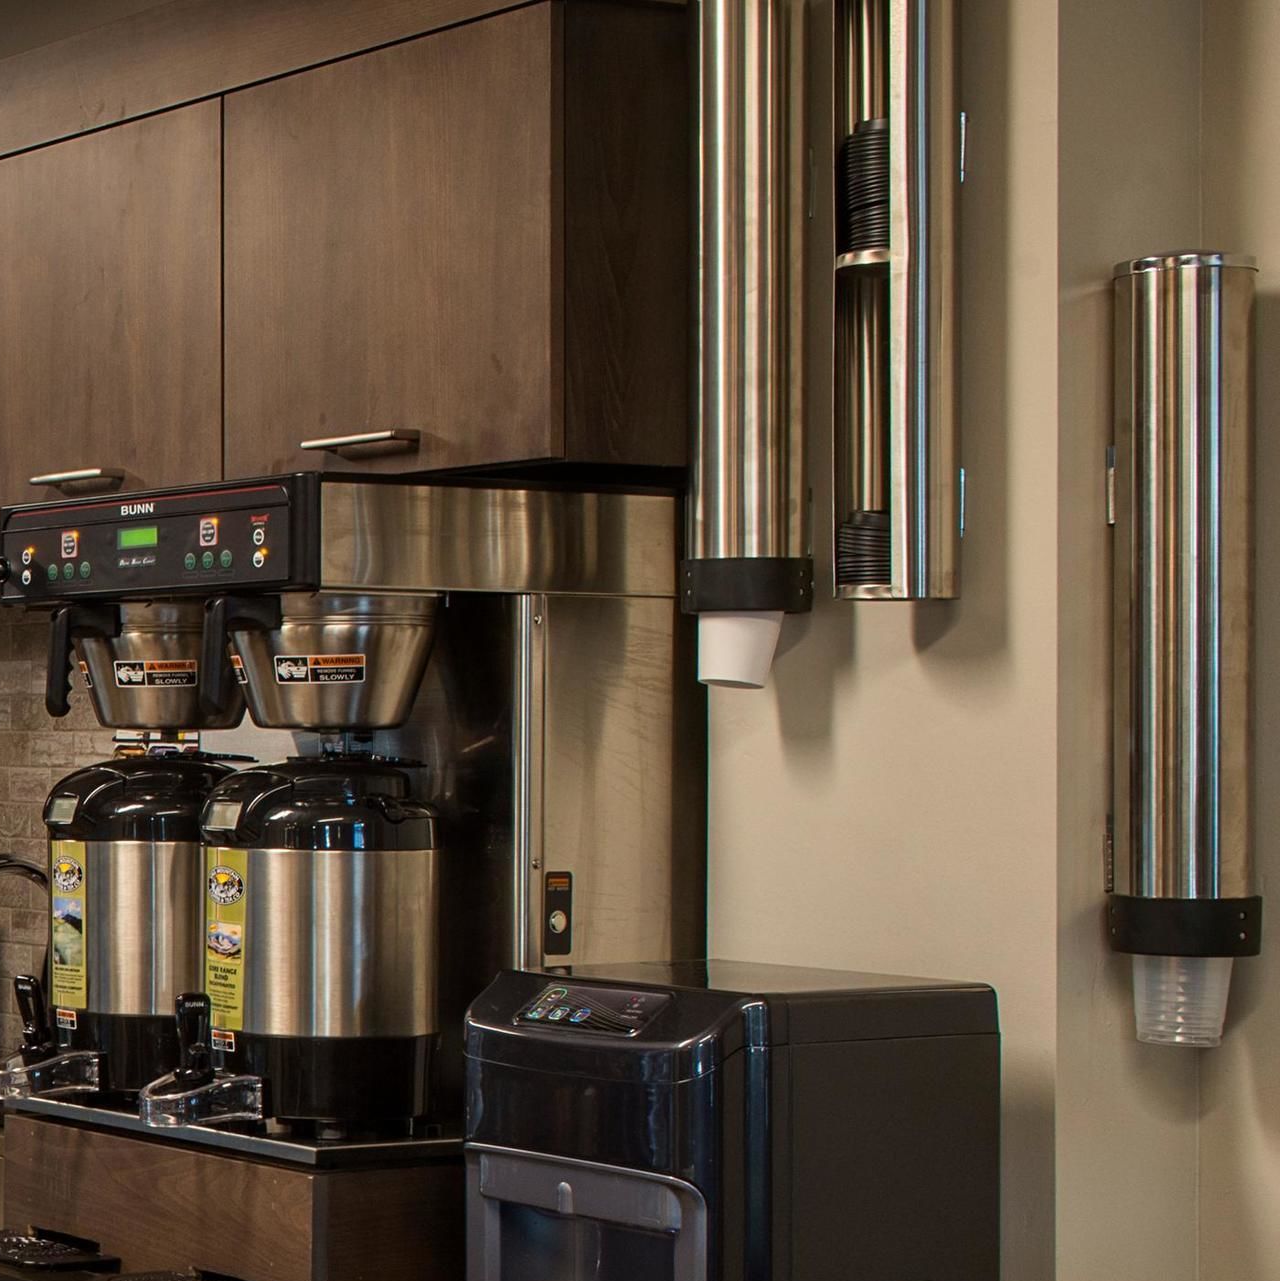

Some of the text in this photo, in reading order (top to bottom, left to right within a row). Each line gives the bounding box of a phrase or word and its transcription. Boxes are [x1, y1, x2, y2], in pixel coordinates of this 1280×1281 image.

[120, 503, 155, 516] BUNN
[322, 657, 361, 666] WARNING
[157, 662, 194, 671] WARNING
[319, 673, 355, 681] SLOWLY
